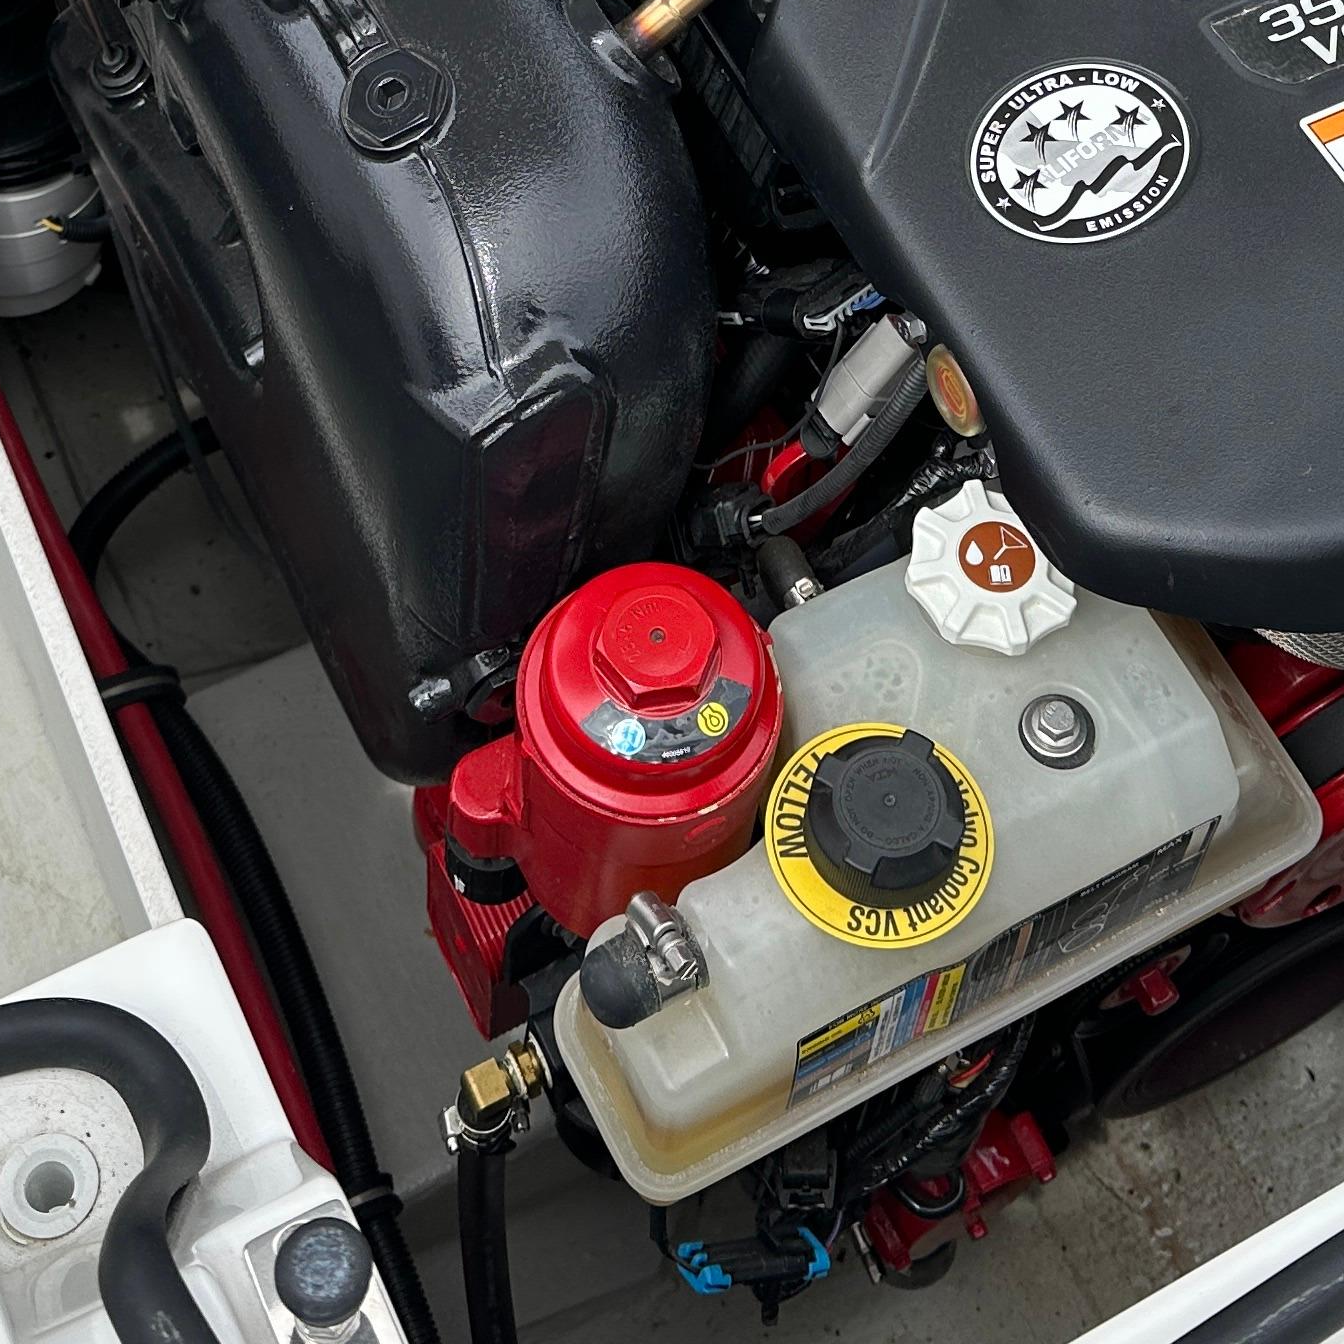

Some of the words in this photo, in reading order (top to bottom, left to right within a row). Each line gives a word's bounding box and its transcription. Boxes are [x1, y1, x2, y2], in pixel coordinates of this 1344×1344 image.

[977, 120, 1006, 183] SUPER
[1008, 73, 1073, 111] ULTRA
[1091, 70, 1139, 92] LOW
[1085, 174, 1170, 232] EMISSION
[846, 905, 901, 937] VCS
[904, 855, 980, 932] Coolant
